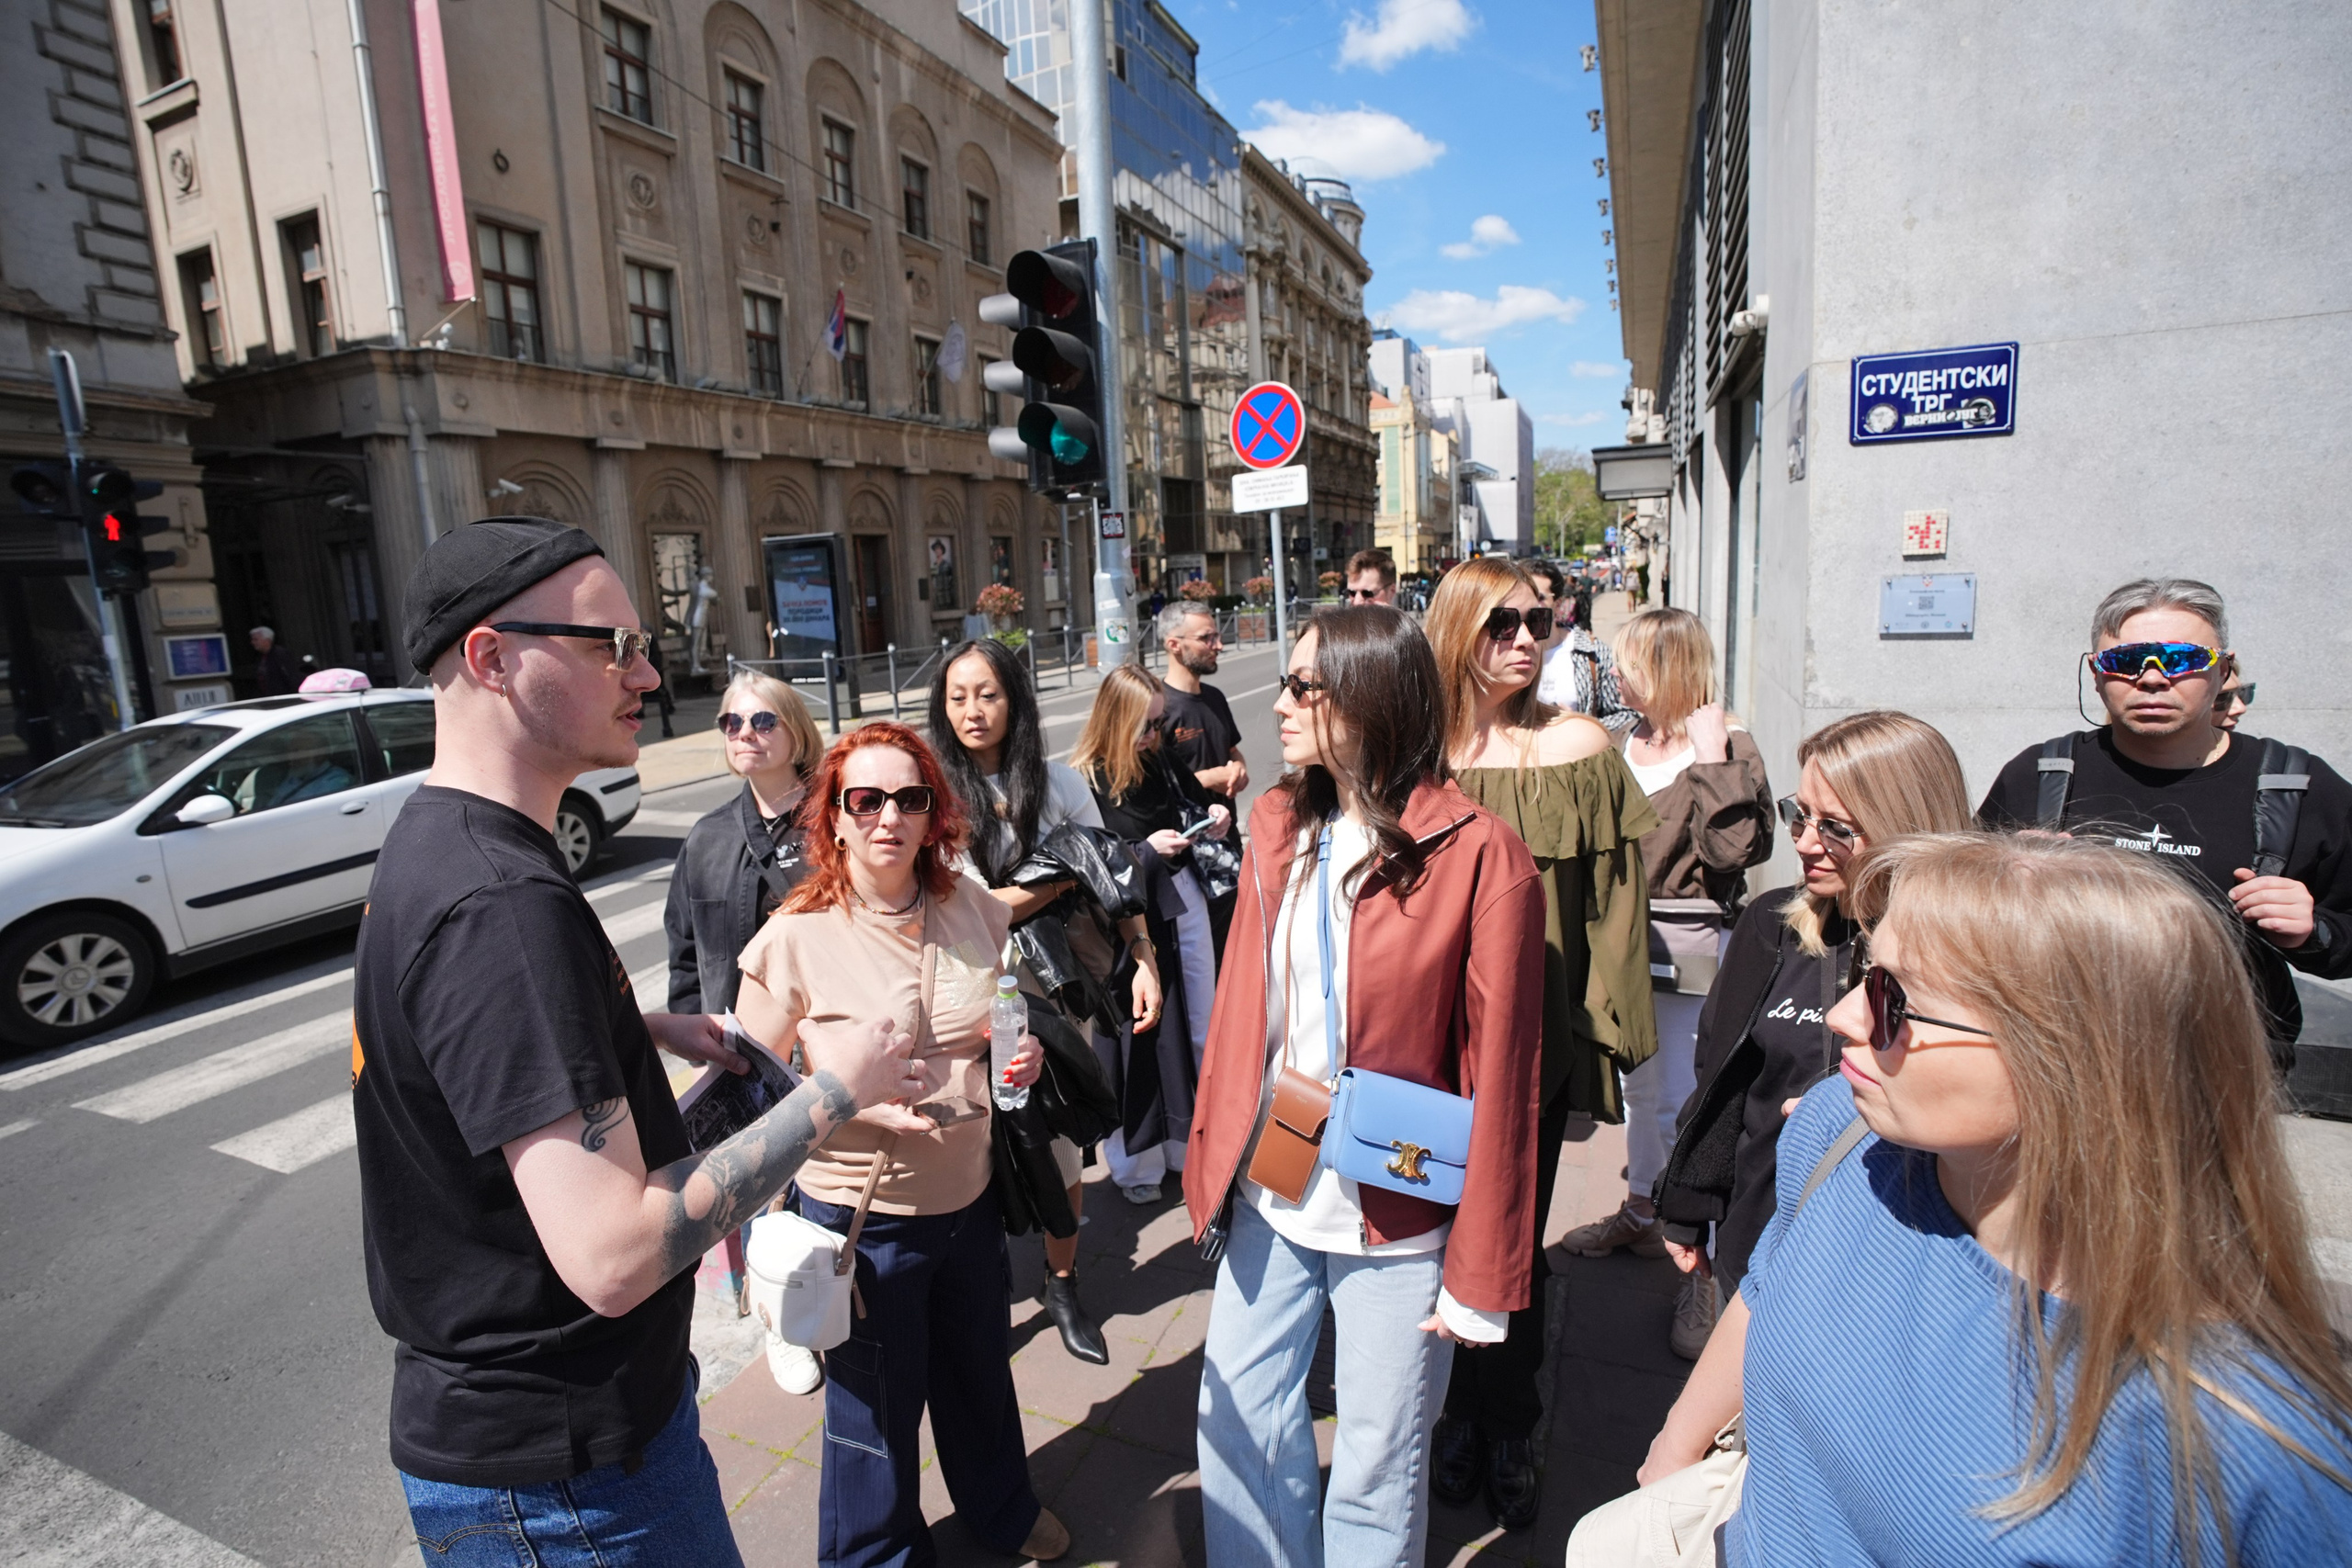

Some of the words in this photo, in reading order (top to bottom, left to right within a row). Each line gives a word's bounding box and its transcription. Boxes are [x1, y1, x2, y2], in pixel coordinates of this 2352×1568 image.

[1860, 364, 2008, 399] СТУДЕНТСКИ
[1910, 393, 1952, 413] ТРГ
[2115, 838, 2151, 851] STONE
[2157, 842, 2201, 856] ISLAND
[1767, 998, 1796, 1020] Le
[1796, 1008, 1823, 1025] pi
